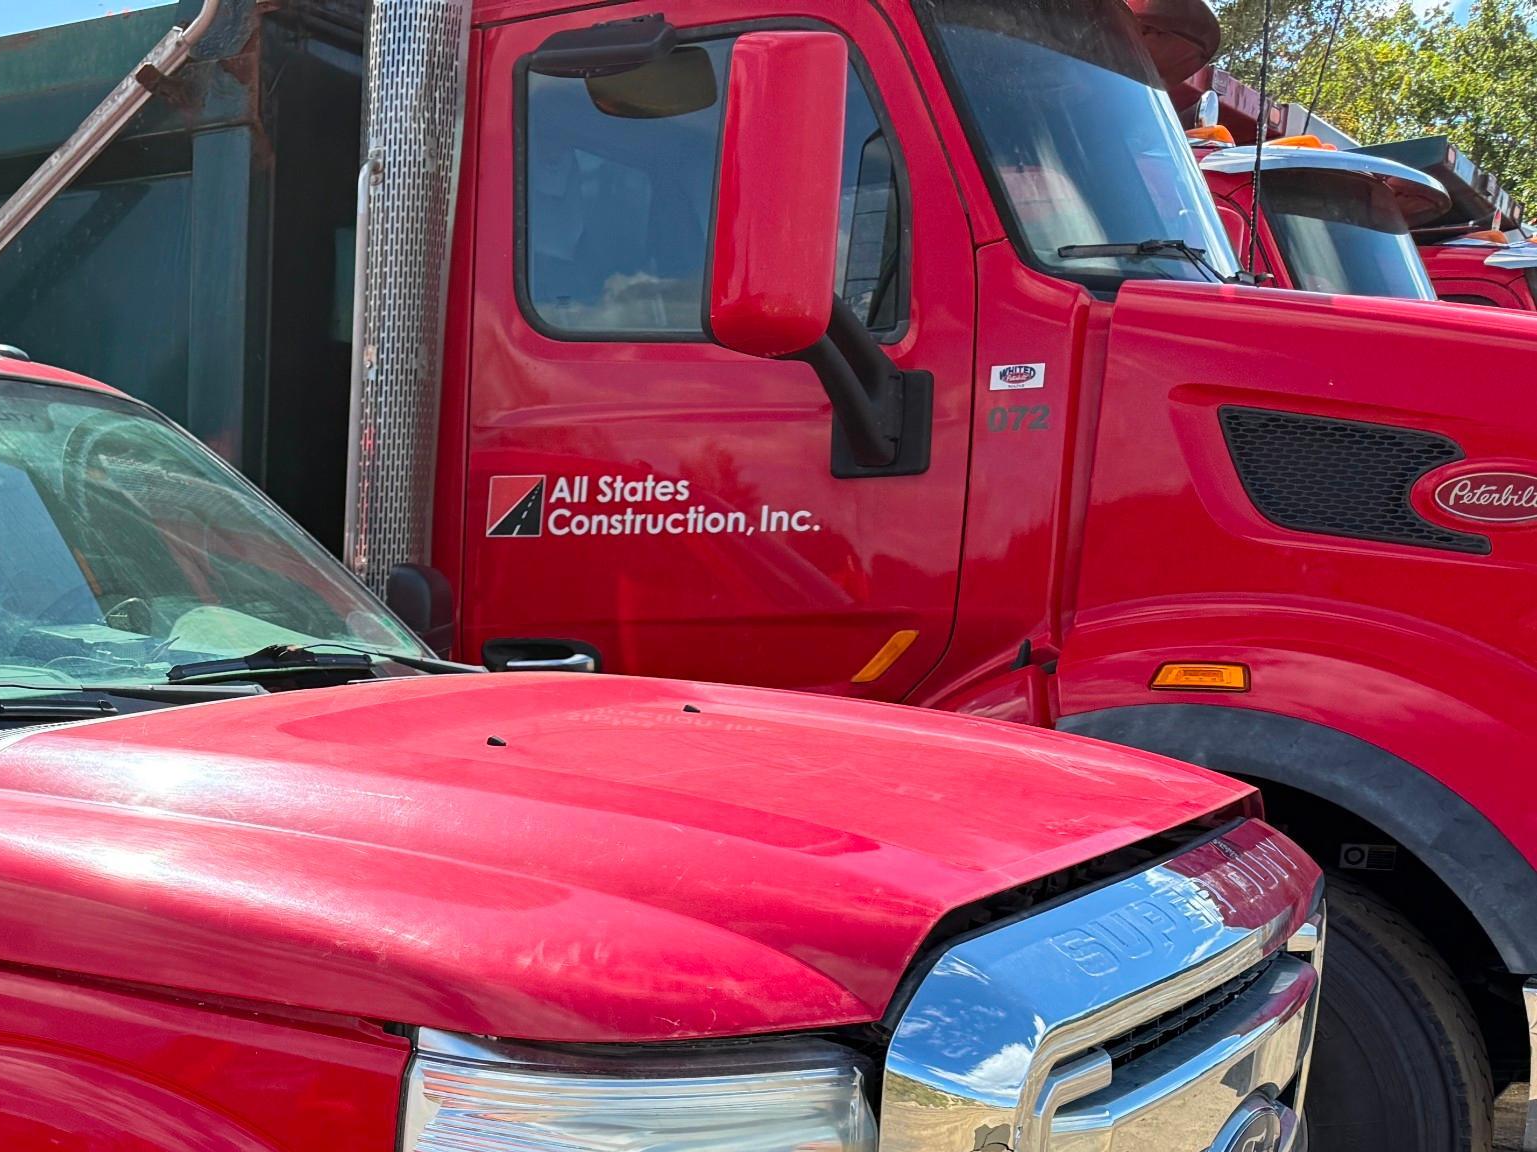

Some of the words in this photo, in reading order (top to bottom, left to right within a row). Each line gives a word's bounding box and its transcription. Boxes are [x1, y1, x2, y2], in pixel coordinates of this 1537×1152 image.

[987, 404, 1050, 433] 072
[550, 476, 588, 503] All
[596, 475, 690, 503] States
[547, 506, 755, 537] Construction,
[760, 506, 821, 532] Inc.
